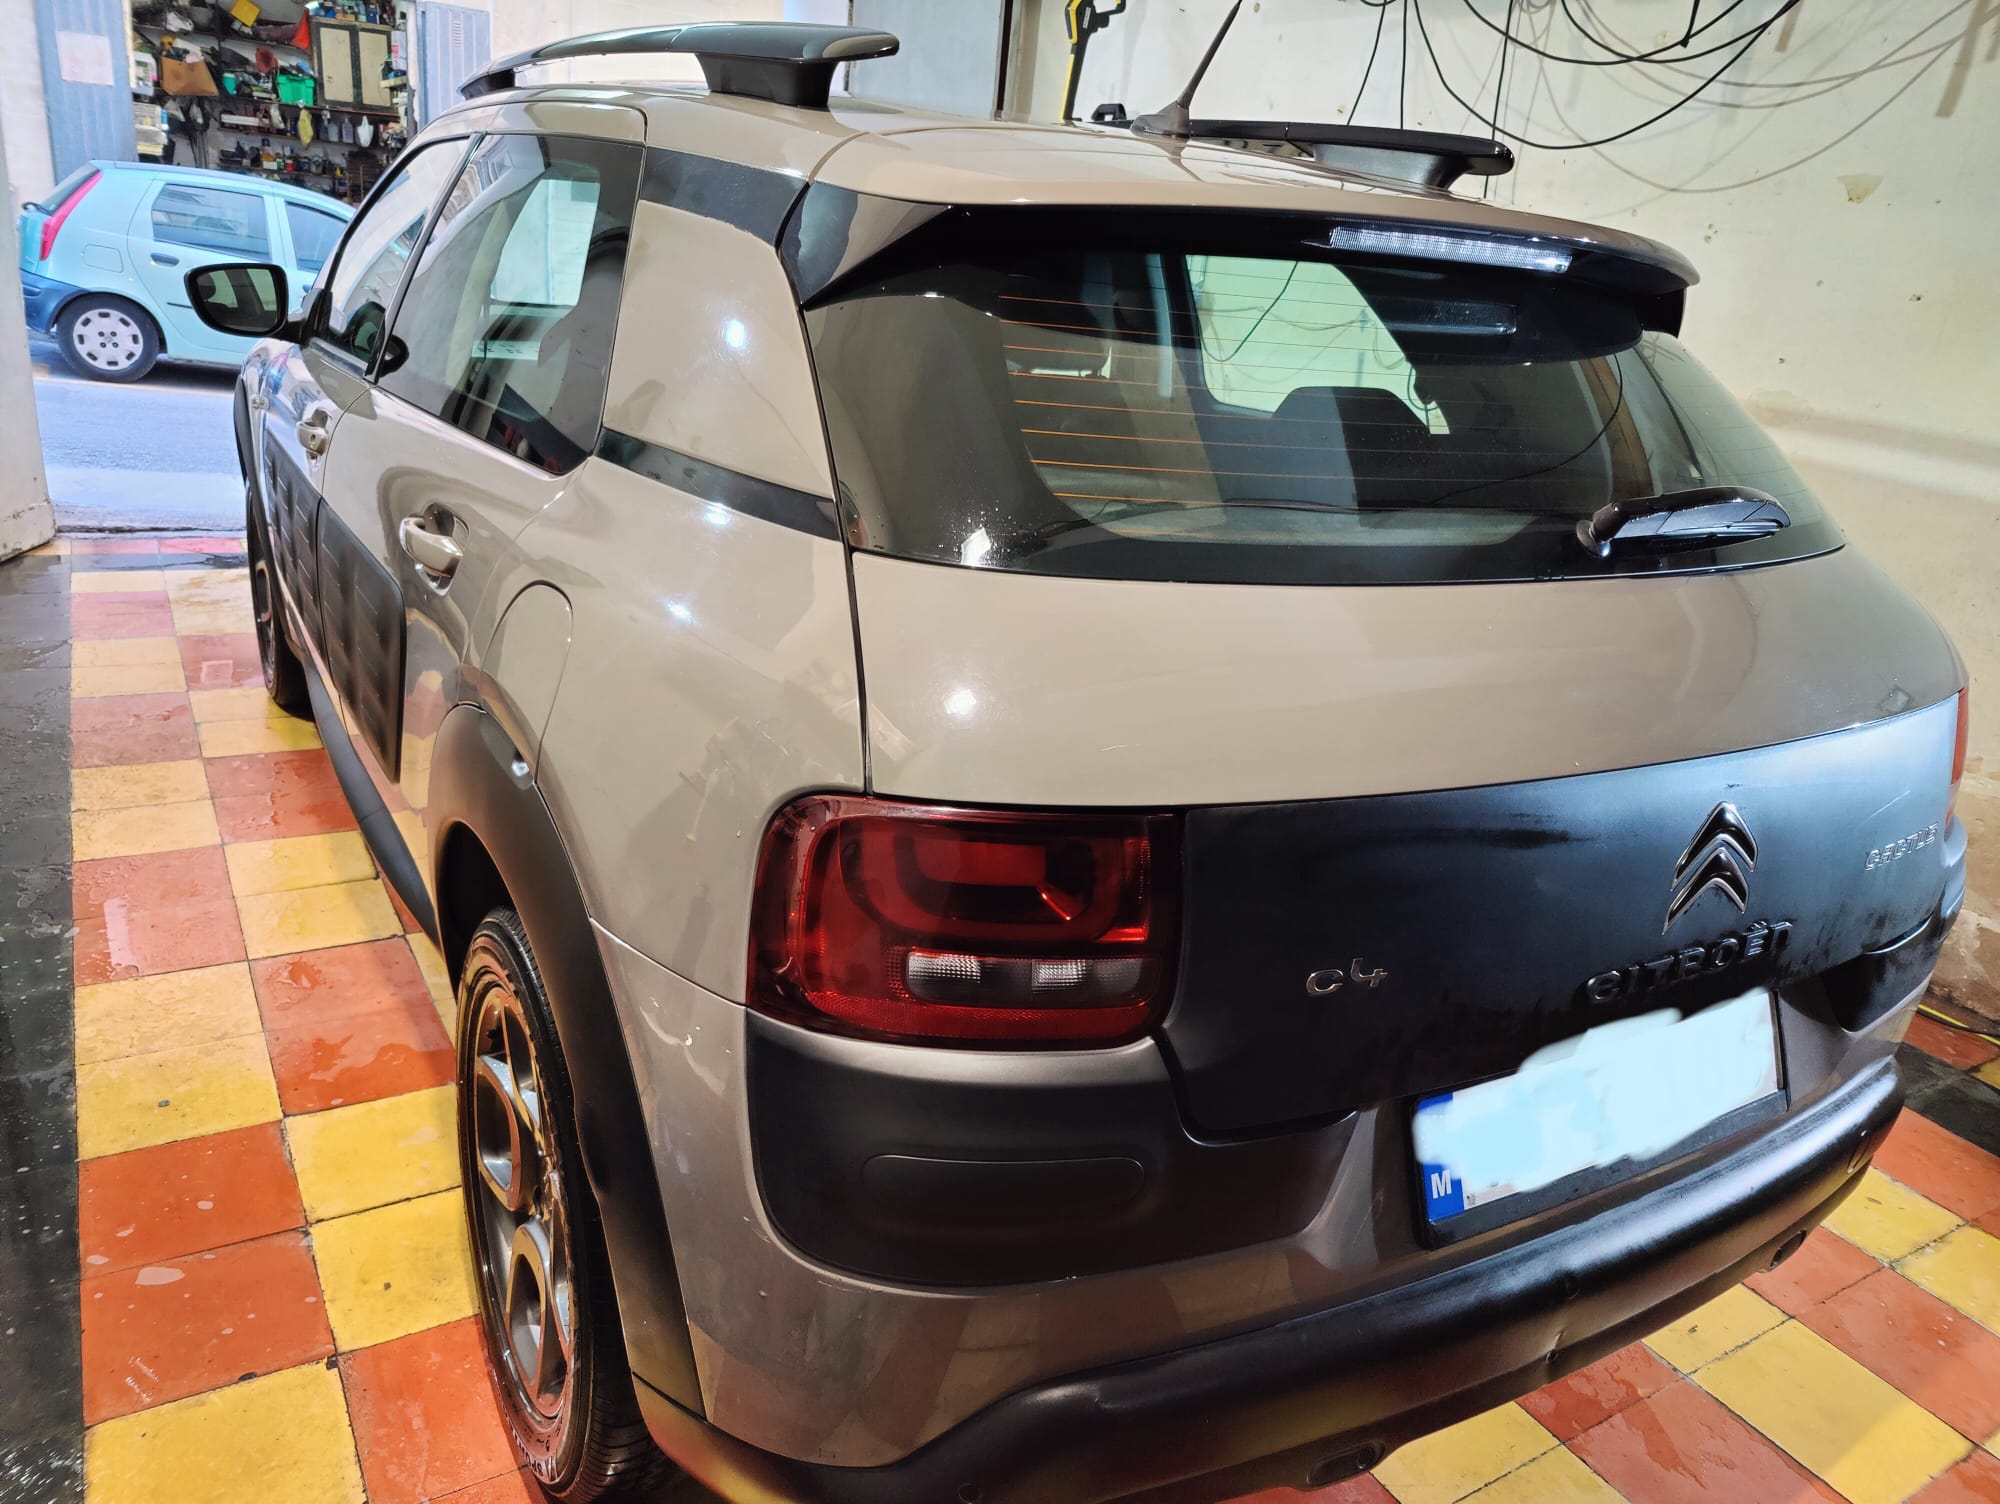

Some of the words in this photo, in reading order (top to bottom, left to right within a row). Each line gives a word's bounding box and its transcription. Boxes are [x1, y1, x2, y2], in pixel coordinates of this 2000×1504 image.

[1864, 822, 1939, 871] CACTUS
[1305, 957, 1389, 997] C4
[1430, 1168, 1453, 1200] M
